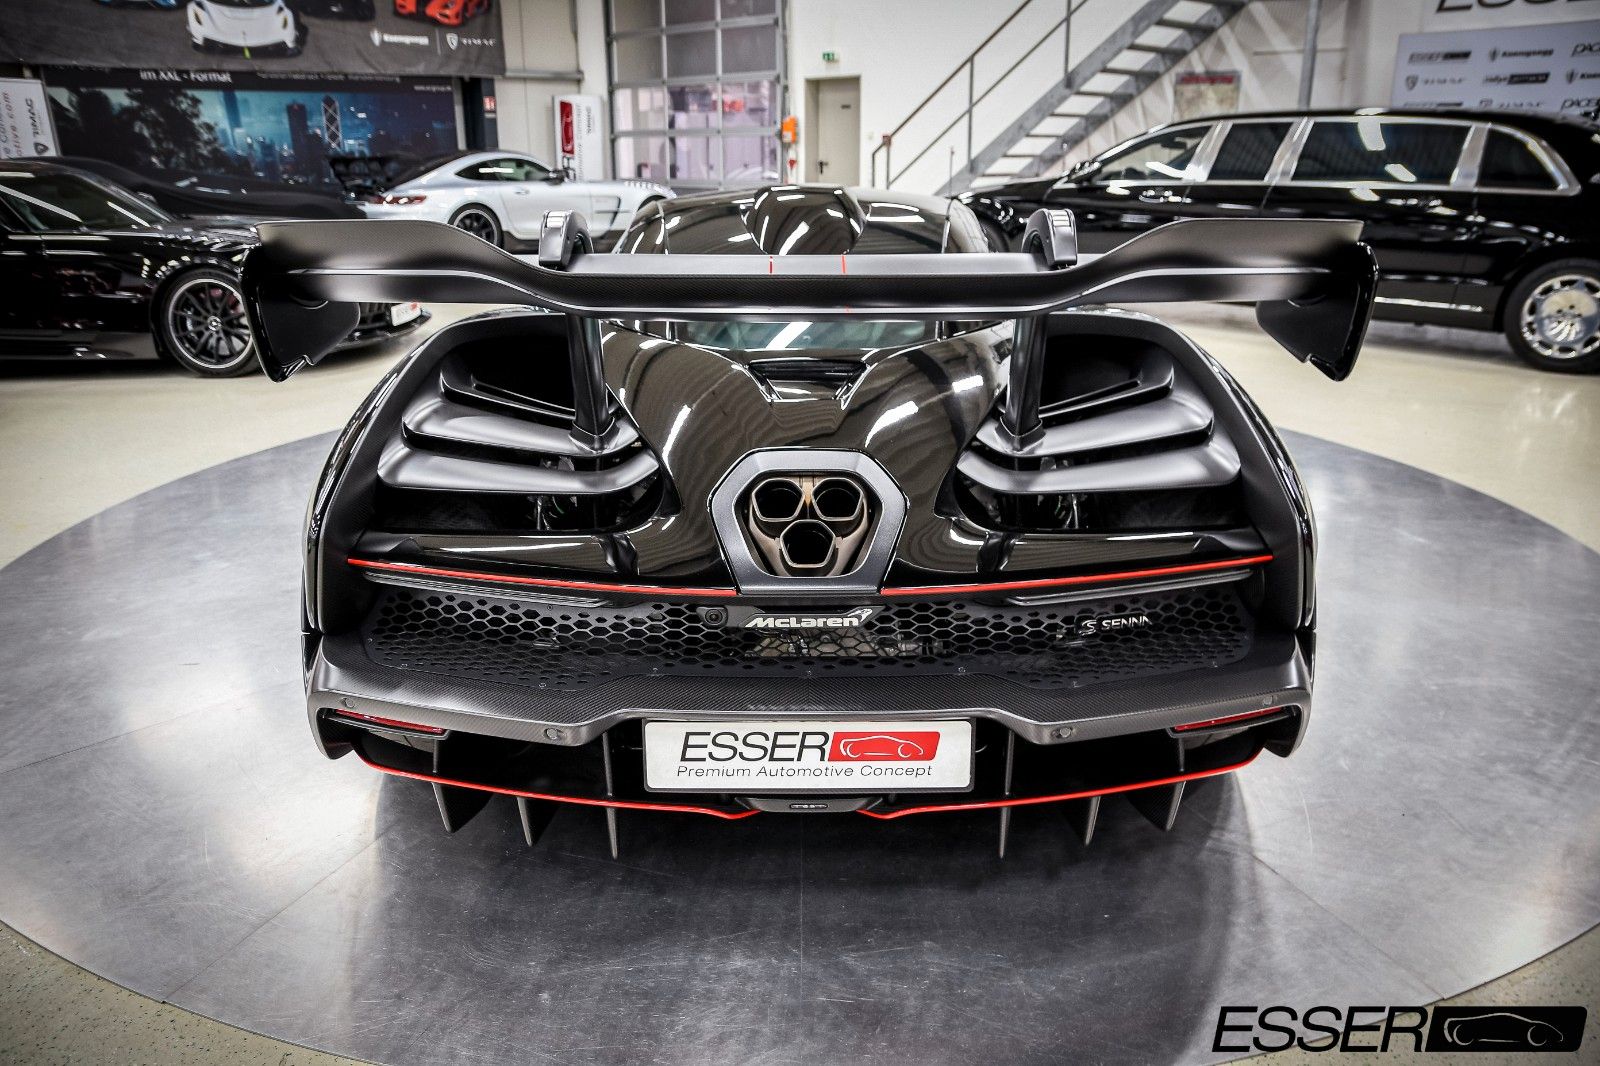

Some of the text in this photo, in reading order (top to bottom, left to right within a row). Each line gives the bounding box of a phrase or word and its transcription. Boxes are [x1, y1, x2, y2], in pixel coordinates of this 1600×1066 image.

[745, 617, 859, 627] McLaren
[1101, 615, 1153, 630] SENNA
[680, 731, 830, 762] ESSER
[677, 764, 933, 778] Premium Automotive Concept
